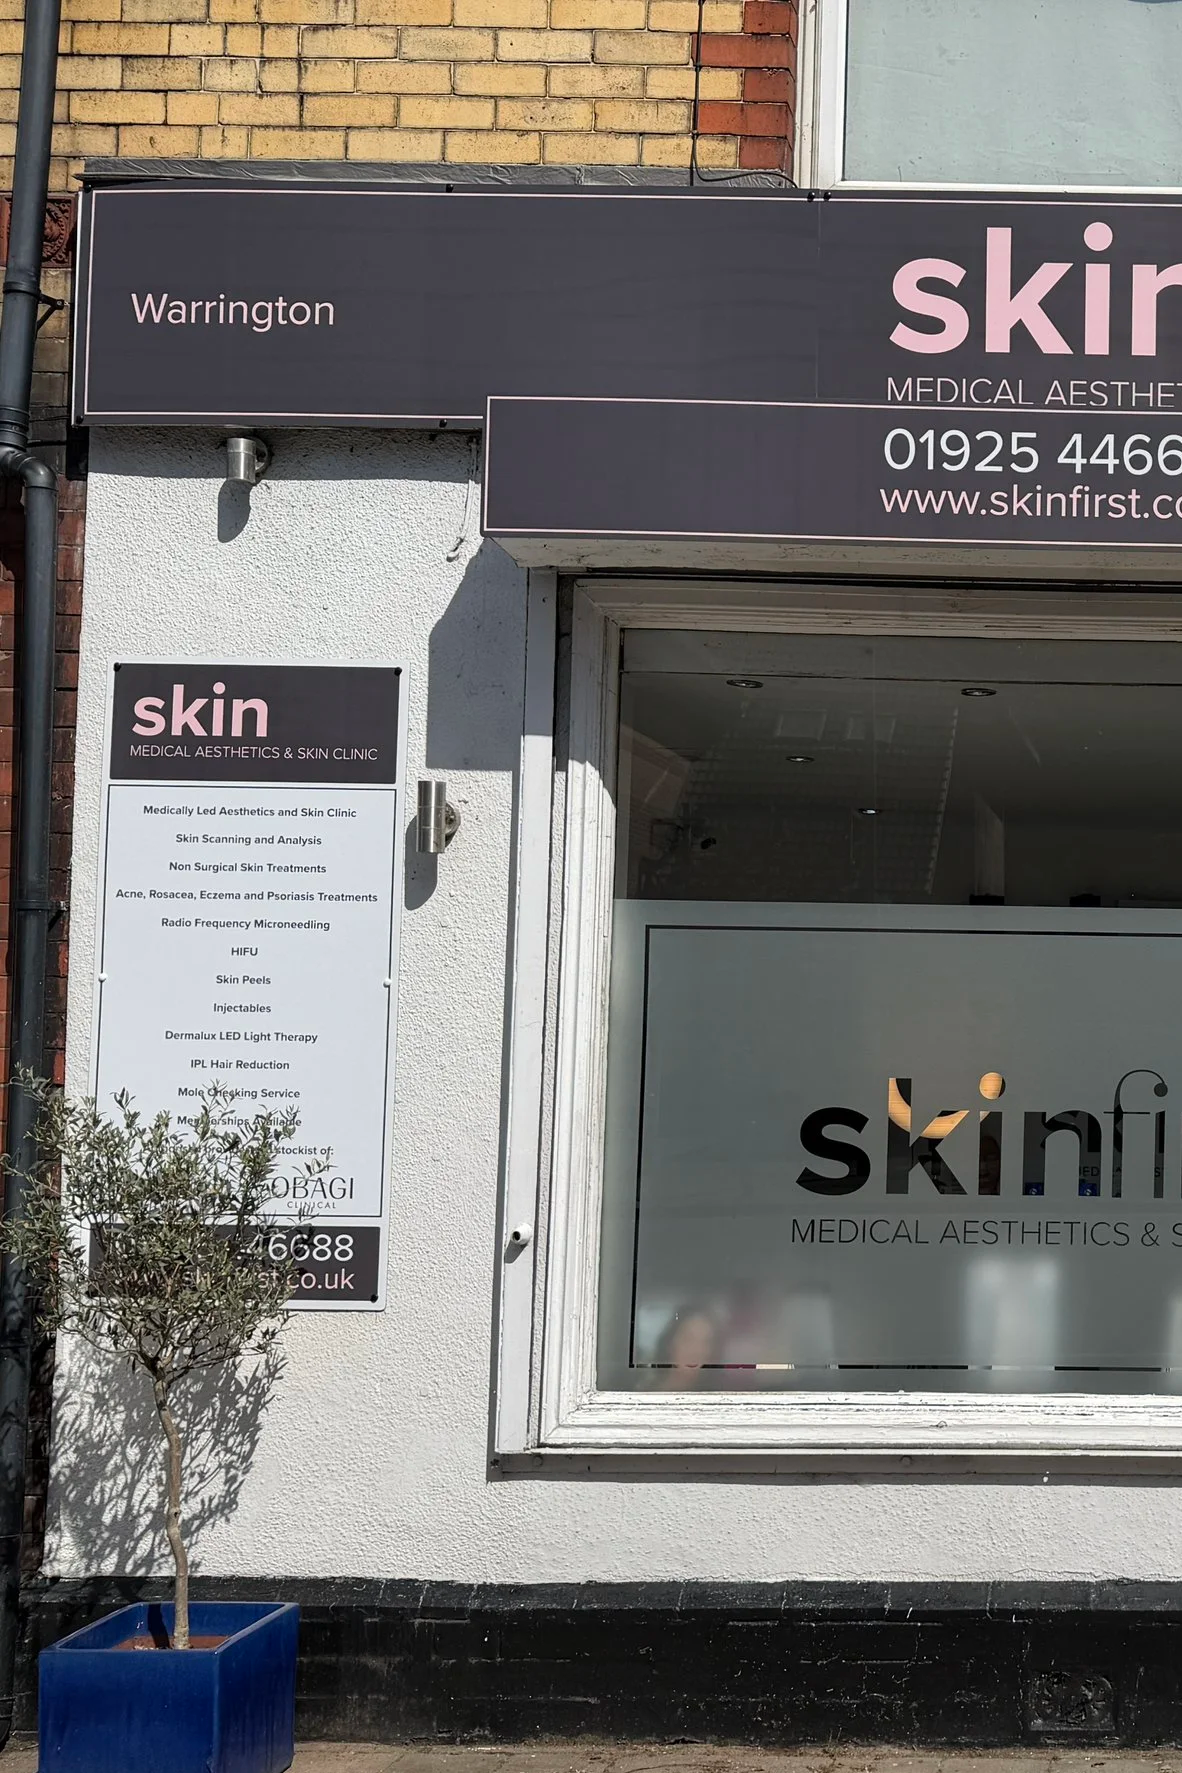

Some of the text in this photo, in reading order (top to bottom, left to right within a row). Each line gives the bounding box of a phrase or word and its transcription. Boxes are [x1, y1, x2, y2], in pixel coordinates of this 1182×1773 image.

[131, 293, 334, 332] Warrington
[886, 376, 1034, 405] MEDICAL
[884, 428, 1039, 473] 01925
[132, 682, 268, 737] skin
[129, 745, 378, 761] MEDICAL AESTHETICS & SKIN CLINIC
[143, 805, 357, 818] Medically Led Aesthetics and Skin Clinic
[176, 834, 322, 847] Skin Scanning and Analysis
[169, 862, 326, 873] Non Surgical Skin Treatments
[116, 889, 378, 902] Acne, Rosacea, Eczema and Psoriasis Treatments
[161, 918, 330, 931] Radio Frequency Microneedling
[231, 947, 258, 956] HIFU
[216, 975, 271, 985] Skin Peels
[213, 1003, 271, 1014] Injectables
[165, 1031, 318, 1044] Dermalux LED Light Therapy
[191, 1060, 289, 1070] IPL Hair Reduction
[178, 1088, 204, 1097] Mole
[260, 1089, 300, 1099] Service
[177, 1116, 250, 1129] Memerships
[320, 1146, 333, 1155] of:
[271, 1177, 354, 1200] OBAGI
[287, 1201, 336, 1209] CLINICAL
[791, 1218, 930, 1244] MEDICAL
[939, 1219, 1131, 1246] AESTHETICS
[1140, 1222, 1162, 1247] &
[226, 1234, 353, 1262] 6688
